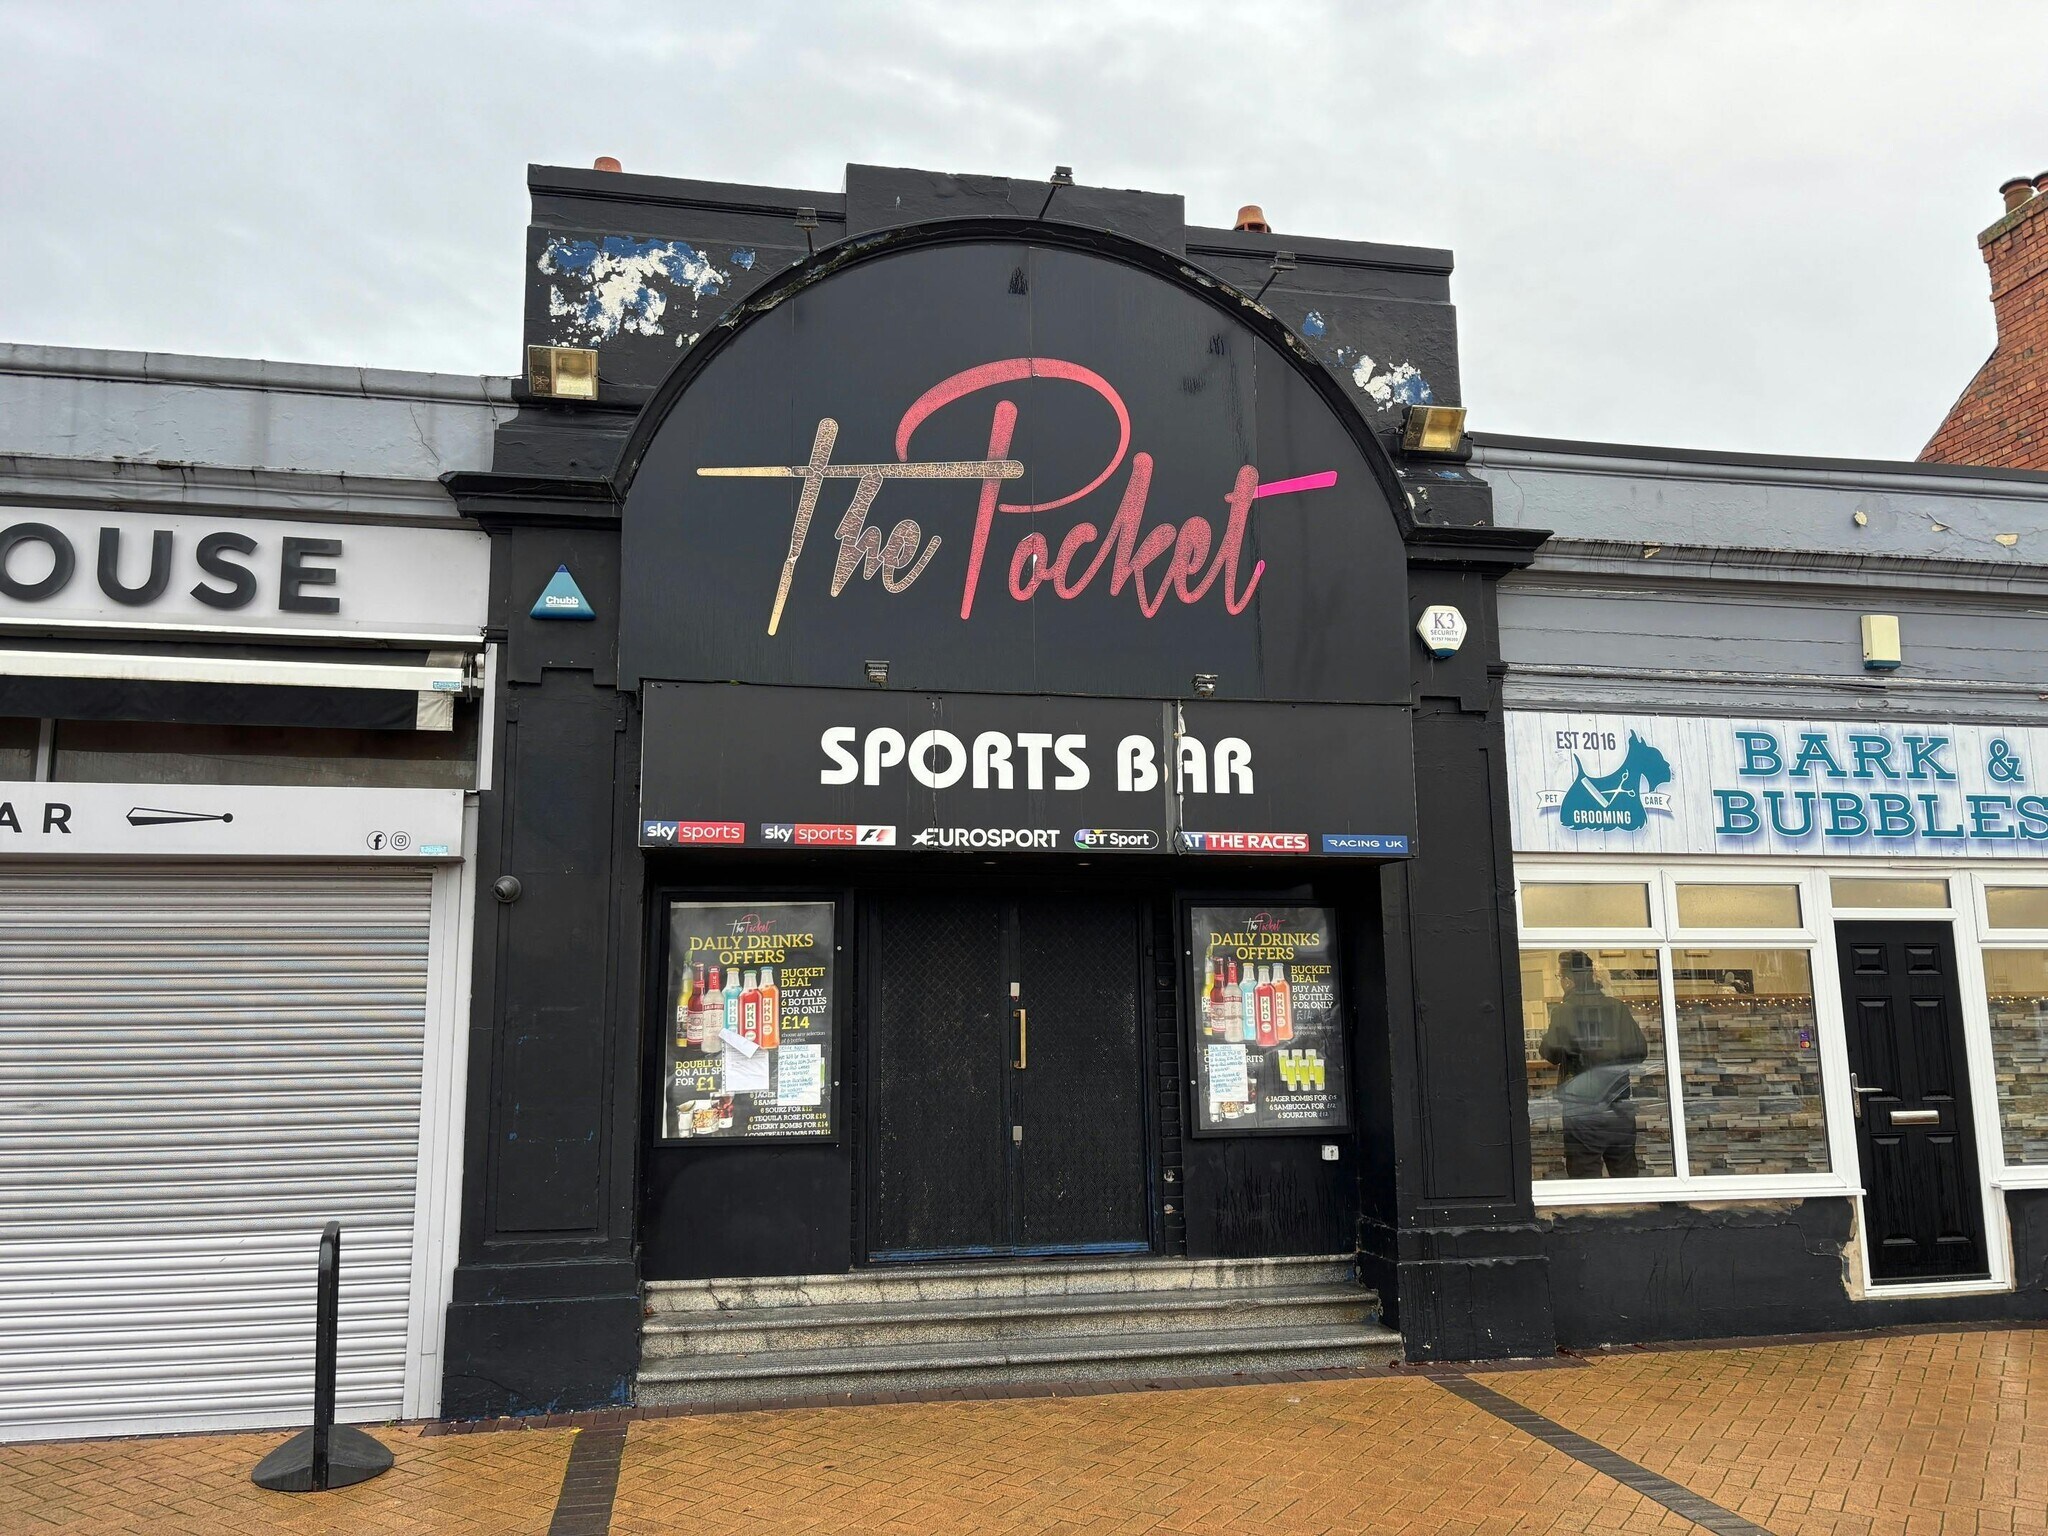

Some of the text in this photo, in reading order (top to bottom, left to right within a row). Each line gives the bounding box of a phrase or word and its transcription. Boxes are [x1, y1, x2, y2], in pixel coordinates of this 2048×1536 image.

[896, 357, 1338, 619] Pocket
[545, 596, 579, 605] Chubb
[1433, 612, 1455, 629] K3
[1556, 731, 1616, 750] EST 2016
[820, 726, 1254, 795] SPORTS BAR
[1735, 731, 2025, 783] BARK &
[1545, 794, 1558, 803] PET
[1644, 796, 1663, 805] CARE
[1573, 810, 1631, 824] GROOMING
[1713, 789, 2048, 840] BUBBLES
[647, 823, 740, 841] sky sports
[764, 825, 793, 842] sky
[798, 828, 854, 842] sports
[911, 828, 1061, 848] EUROSPORT
[1085, 833, 1149, 847] BT Sport
[1184, 834, 1307, 849] AT THE RACES
[1328, 839, 1380, 848] RACING
[690, 933, 814, 951] DAILY DRINKS
[1210, 933, 1320, 946] DAILY DRINKS
[719, 949, 785, 965] OFFERS
[1236, 946, 1294, 960] OFFERS
[781, 967, 826, 978] BUCKET
[1291, 965, 1331, 974] BUCKET
[781, 978, 812, 988] DEAL
[1291, 975, 1318, 983] DEAL
[781, 988, 824, 998] BUY ANY
[1292, 985, 1330, 993] BUY ANY
[788, 997, 827, 1006] BOTTLES
[1299, 993, 1334, 1001] BOTTLES
[781, 1005, 827, 1015] FOR ONLY
[1293, 1001, 1334, 1009] FOR ONLY
[747, 1004, 755, 1029] WKD
[781, 1015, 810, 1030] £14
[1247, 1055, 1264, 1063] RITS
[675, 1060, 713, 1069] DOUBLE
[675, 1068, 691, 1077] ON
[692, 1067, 710, 1076] ALL
[675, 1078, 695, 1086] FOR
[696, 1076, 716, 1091] £1
[1274, 1103, 1310, 1111] SAMBUCCA
[754, 1115, 783, 1123] TEQUILA
[1282, 1111, 1304, 1119] SOURZ
[752, 1123, 779, 1131] CHERRY
